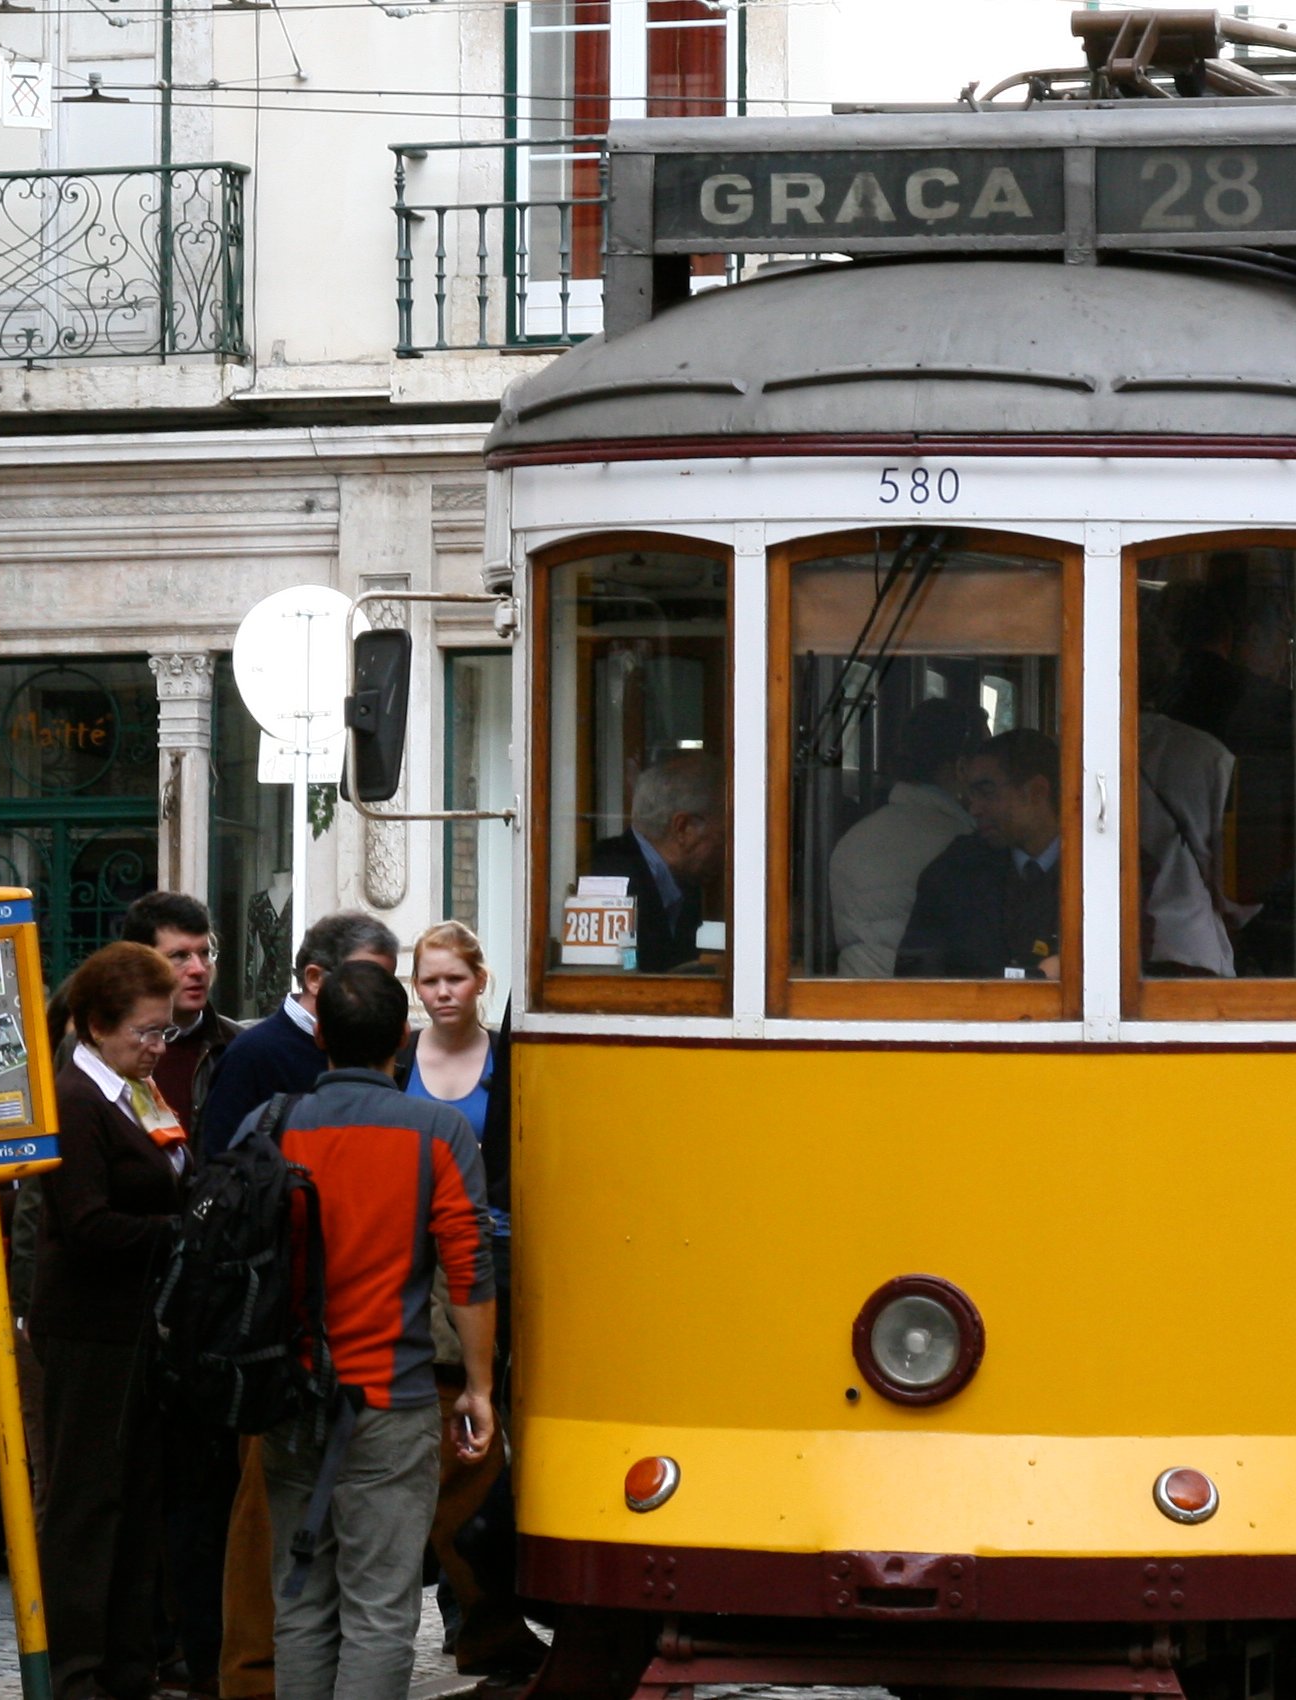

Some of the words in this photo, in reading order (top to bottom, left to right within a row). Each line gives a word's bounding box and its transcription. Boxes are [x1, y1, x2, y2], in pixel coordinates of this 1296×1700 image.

[699, 166, 1035, 227] GRAÇA
[1138, 152, 1264, 231] 28
[878, 466, 960, 505] 580
[565, 911, 600, 943] 28E
